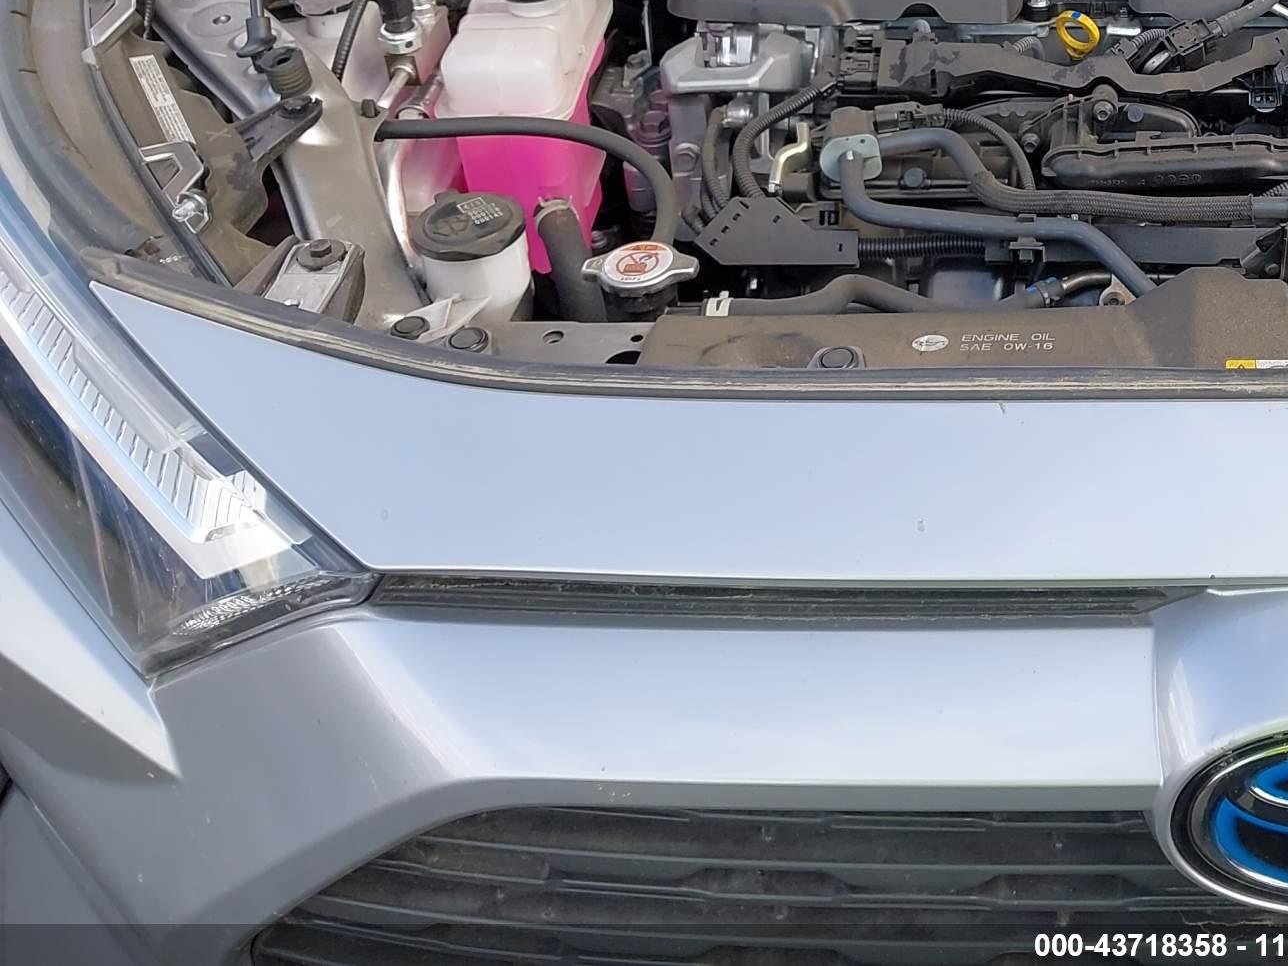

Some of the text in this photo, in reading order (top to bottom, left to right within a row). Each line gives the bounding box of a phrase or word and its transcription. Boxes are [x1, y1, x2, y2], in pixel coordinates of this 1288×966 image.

[961, 333, 1056, 342] ENGINE OIL
[959, 342, 1054, 351] SAE 0W-16
